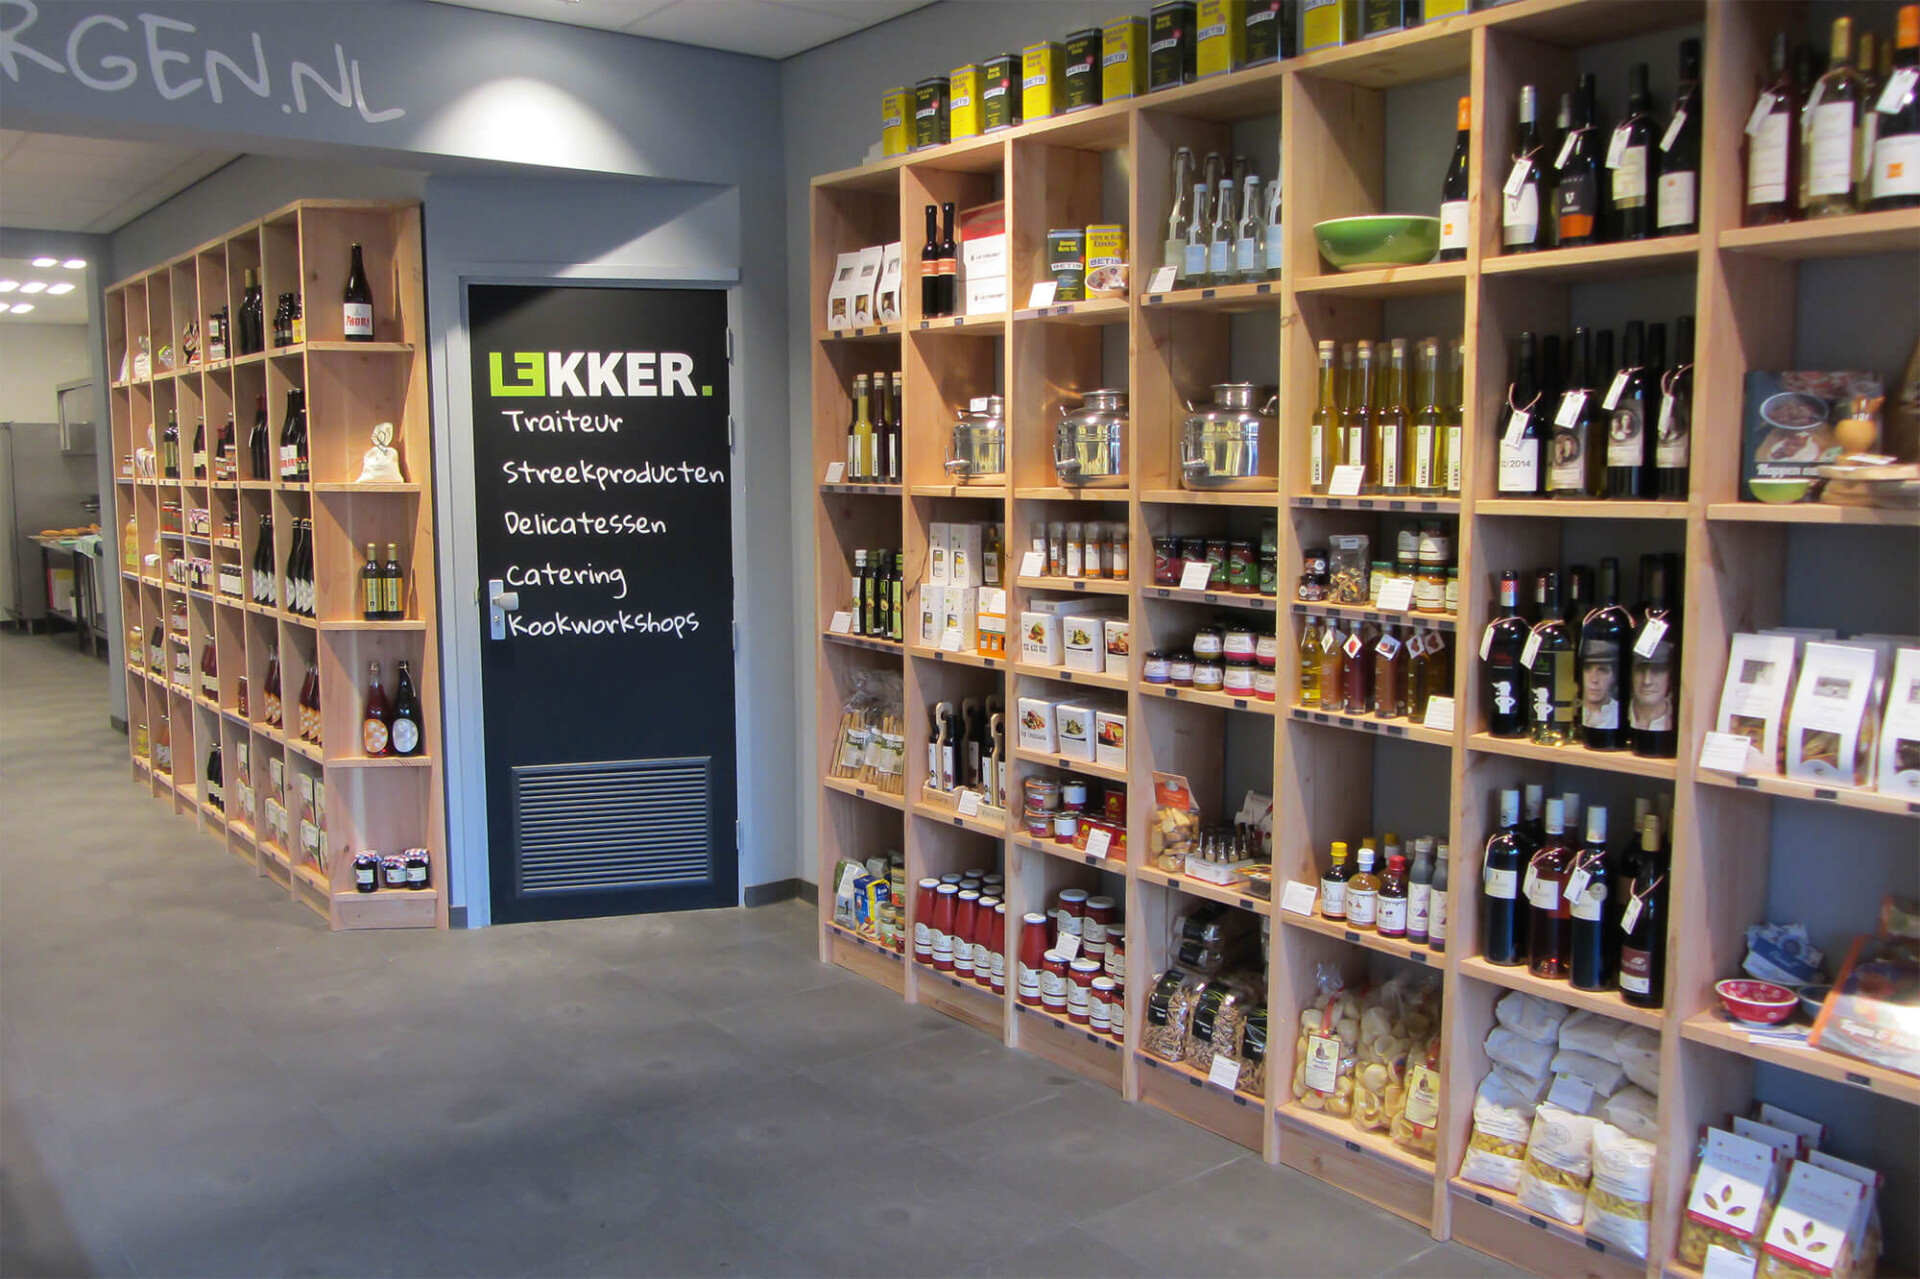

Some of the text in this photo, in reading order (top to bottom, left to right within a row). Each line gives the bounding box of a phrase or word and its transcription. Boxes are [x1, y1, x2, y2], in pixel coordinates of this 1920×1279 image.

[501, 410, 623, 433] Traiteur
[503, 460, 725, 490] Streekproducten
[504, 511, 667, 535] Delicatessen
[506, 563, 628, 599] Catering
[508, 610, 700, 639] Kookworkshops
